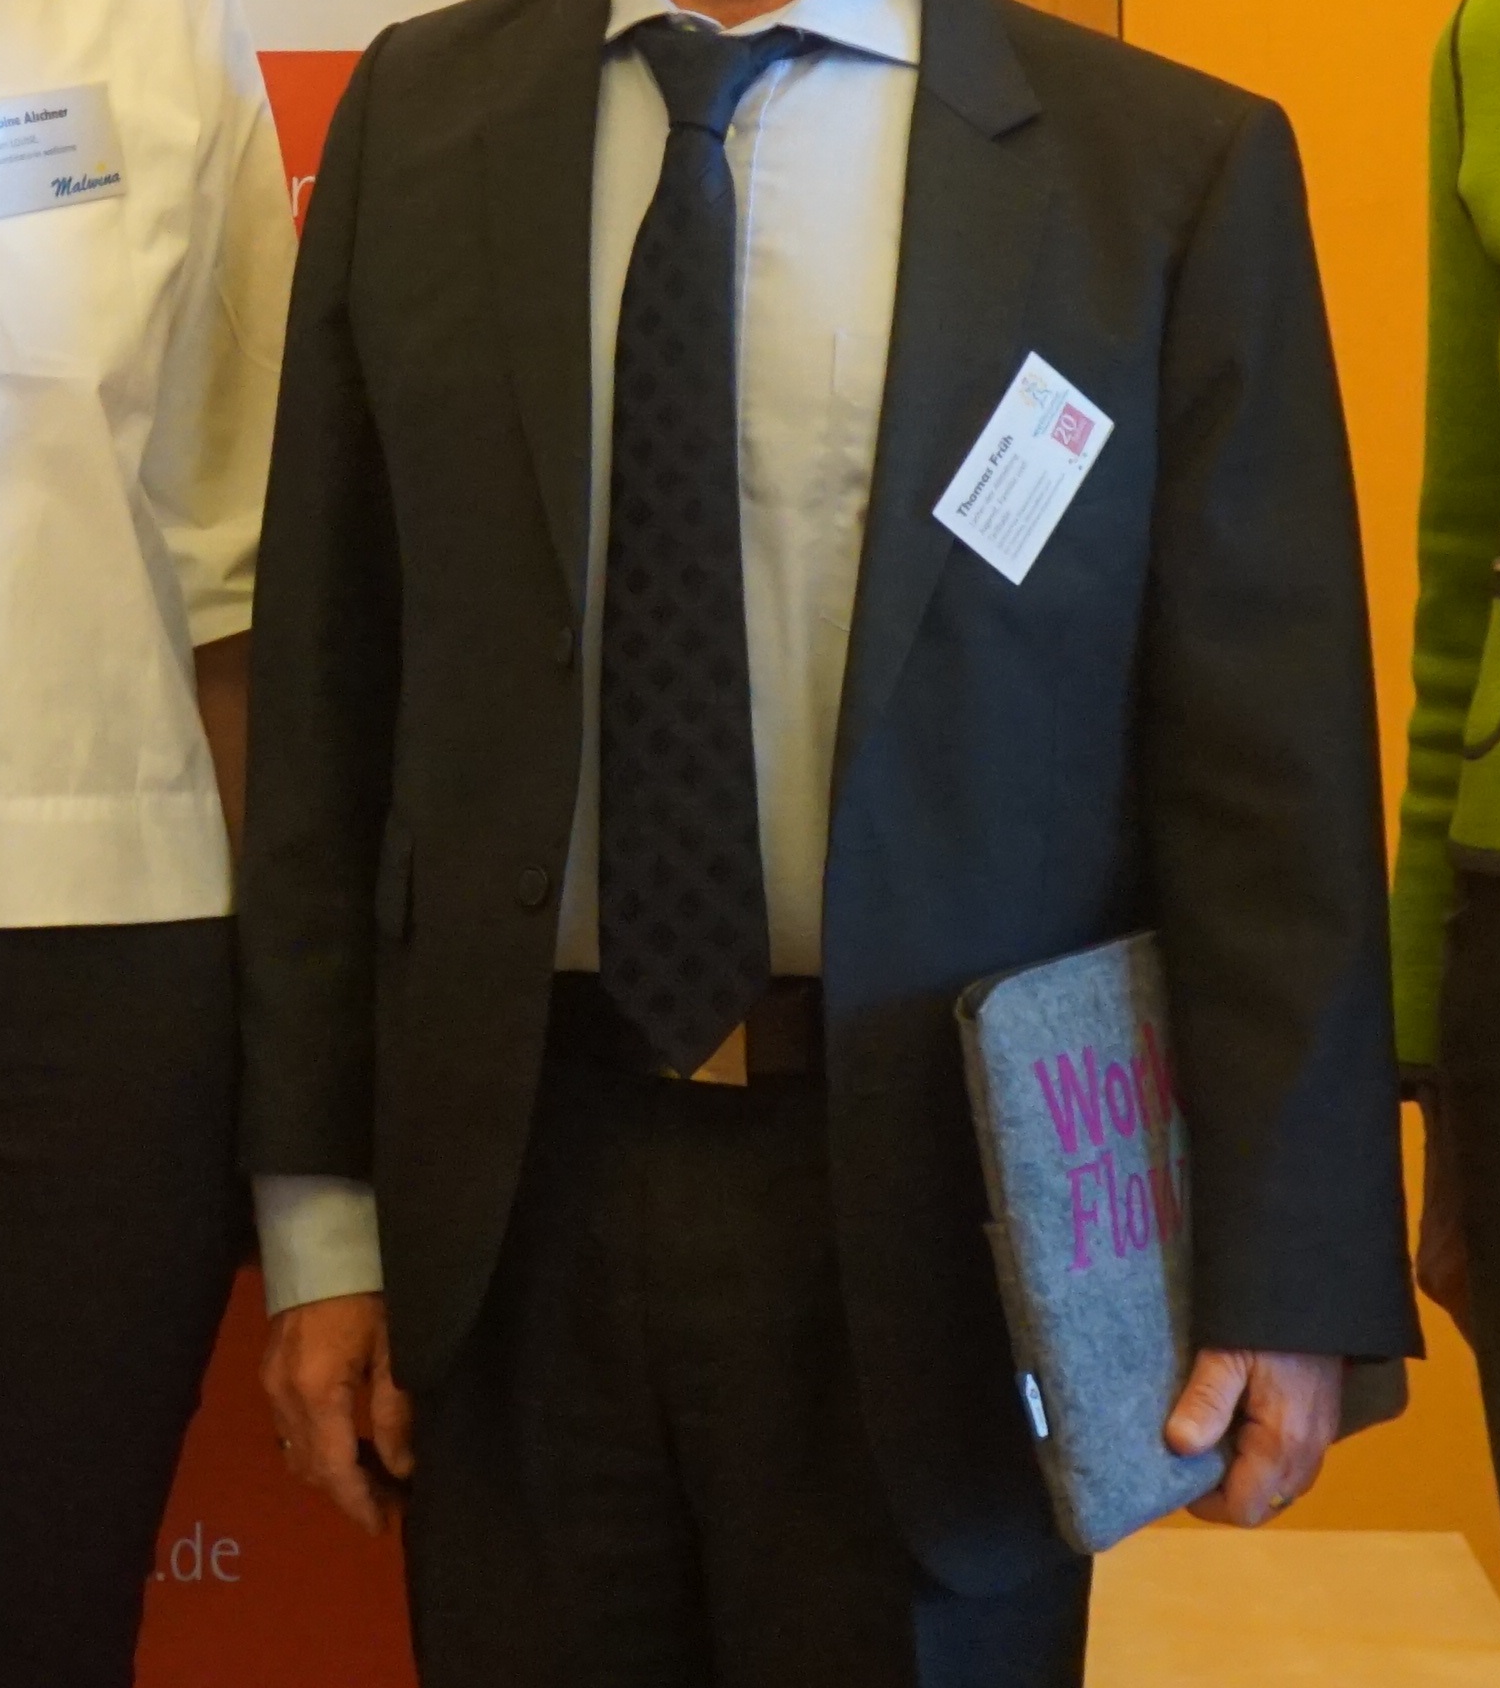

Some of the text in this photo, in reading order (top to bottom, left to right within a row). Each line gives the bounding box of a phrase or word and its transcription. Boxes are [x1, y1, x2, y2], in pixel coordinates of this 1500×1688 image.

[50, 171, 121, 197] Malwina
[1054, 412, 1078, 446] 20
[956, 467, 994, 518] Thomas
[988, 433, 1014, 467] Früh
